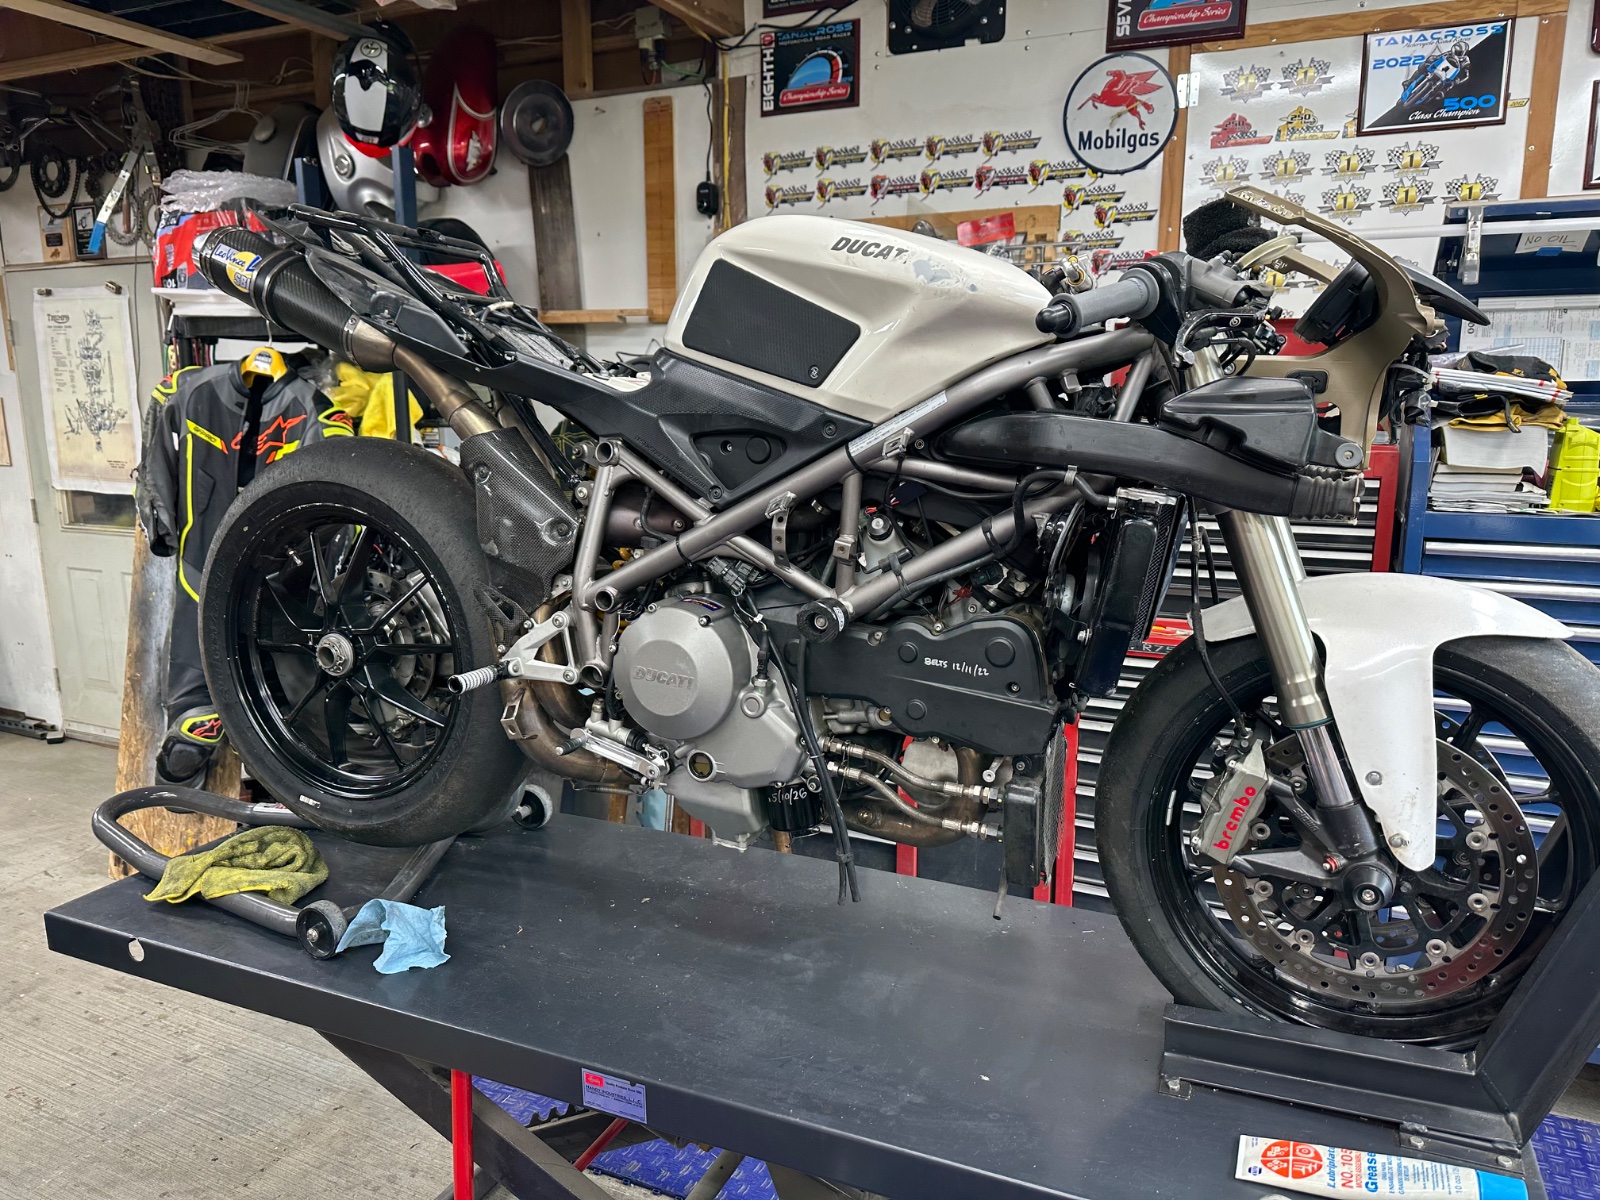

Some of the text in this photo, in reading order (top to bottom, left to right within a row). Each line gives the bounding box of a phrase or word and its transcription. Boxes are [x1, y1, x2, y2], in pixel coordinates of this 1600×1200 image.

[1143, 6, 1227, 24] Championship Series
[1375, 24, 1503, 47] TANACROSS
[1372, 54, 1426, 70] 2022
[762, 49, 775, 112] EIGHTH
[783, 86, 847, 101] Championship Series
[1443, 94, 1497, 111] 500
[1225, 120, 1245, 128] 250
[1290, 113, 1311, 121] 250
[1408, 106, 1481, 121] Class Champion
[1078, 128, 1160, 154] Mobilgas
[830, 236, 909, 262] DUCAT
[1525, 235, 1575, 246] NO OIL
[214, 244, 246, 267] LeoVince
[633, 665, 695, 690] DUCATI
[924, 657, 990, 677] BELTS 12/11/22
[1213, 786, 1256, 851] brembo
[1292, 807, 1320, 833] SHOWA
[1340, 1148, 1353, 1189] NO. 105
[1365, 1151, 1378, 1192] Grease
[1455, 1185, 1462, 1193] 10
